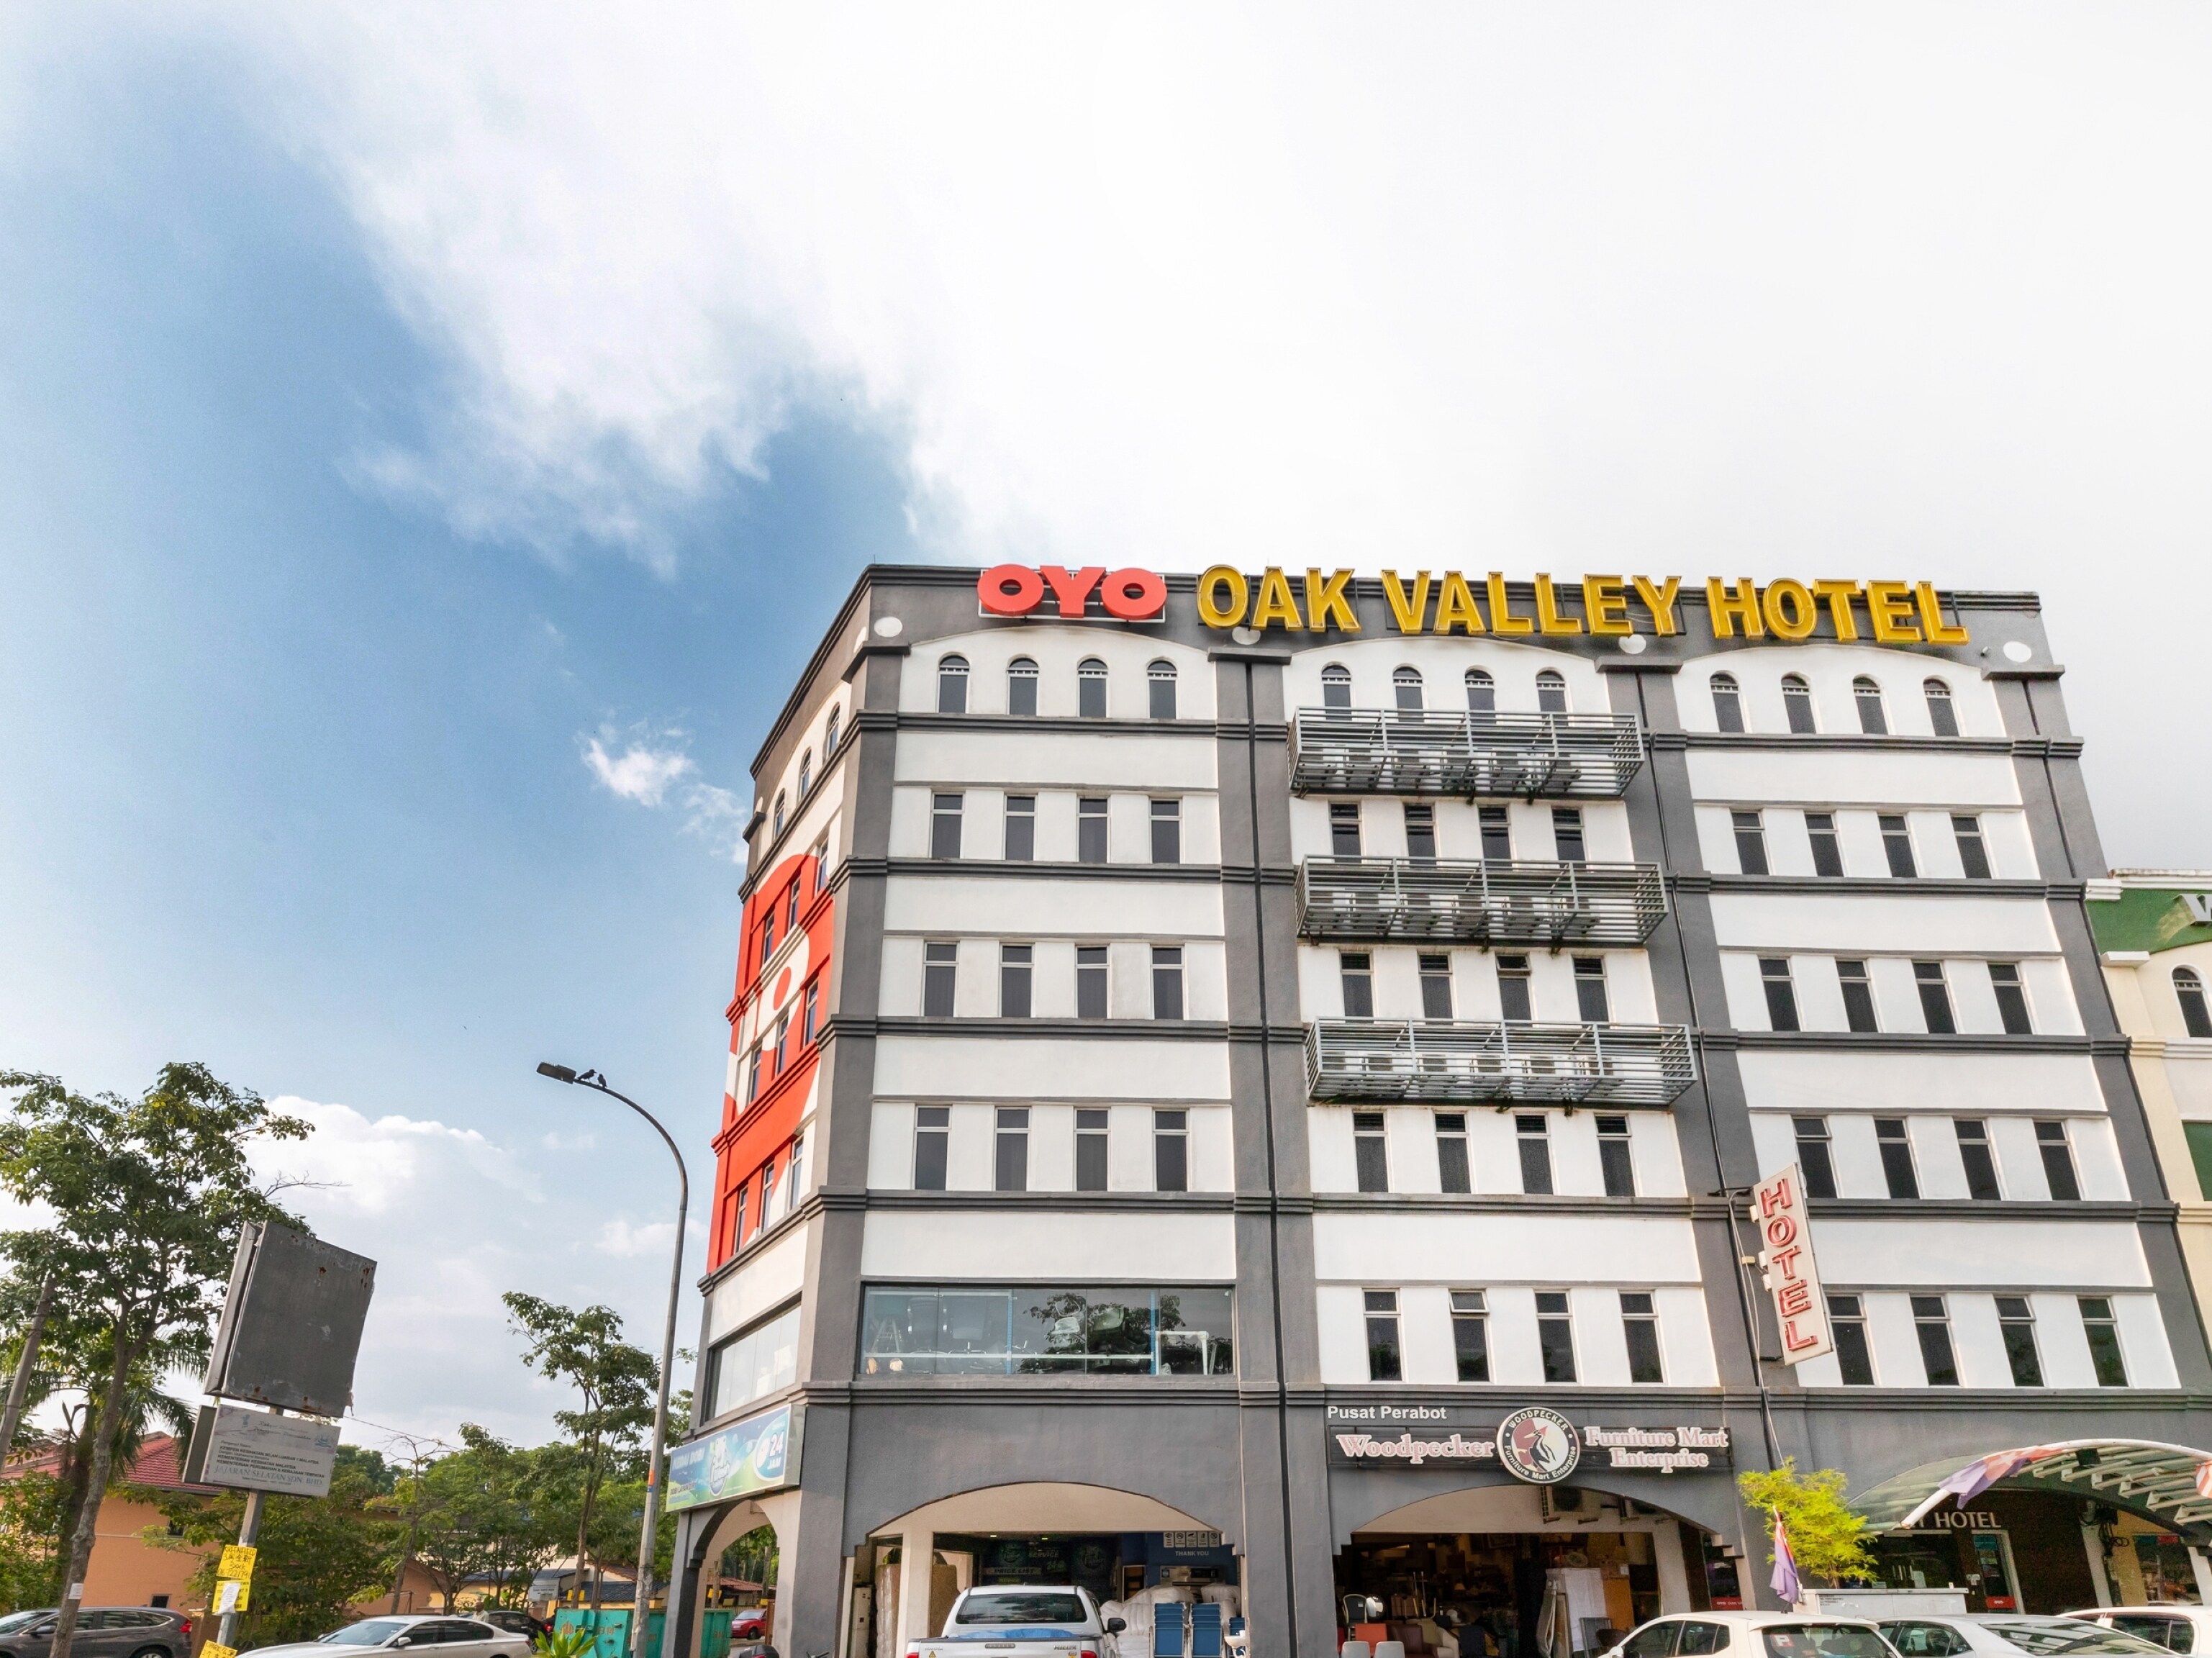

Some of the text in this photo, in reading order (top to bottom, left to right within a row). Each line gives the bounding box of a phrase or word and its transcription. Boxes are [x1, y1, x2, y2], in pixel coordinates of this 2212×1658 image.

[977, 563, 1168, 620] OYO
[1197, 564, 1970, 645] OAK VALLEY HOTEL
[1759, 1178, 1818, 1351] HOTEL
[1327, 1405, 1447, 1420] Pusat Perabot
[1508, 1410, 1569, 1431] WOODPECKER
[769, 1430, 784, 1457] 24
[1336, 1433, 1495, 1464] Woodpecker
[1584, 1426, 1729, 1448] Furniture Mart
[214, 1465, 250, 1476] JAJARAN
[252, 1468, 287, 1480] SELATAN
[1504, 1445, 1530, 1475] Furniture
[1551, 1446, 1577, 1478] Enterprise
[1609, 1447, 1709, 1474] Enterprise
[1934, 1511, 2002, 1528] HOTEL
[1774, 1634, 1790, 1646] P
